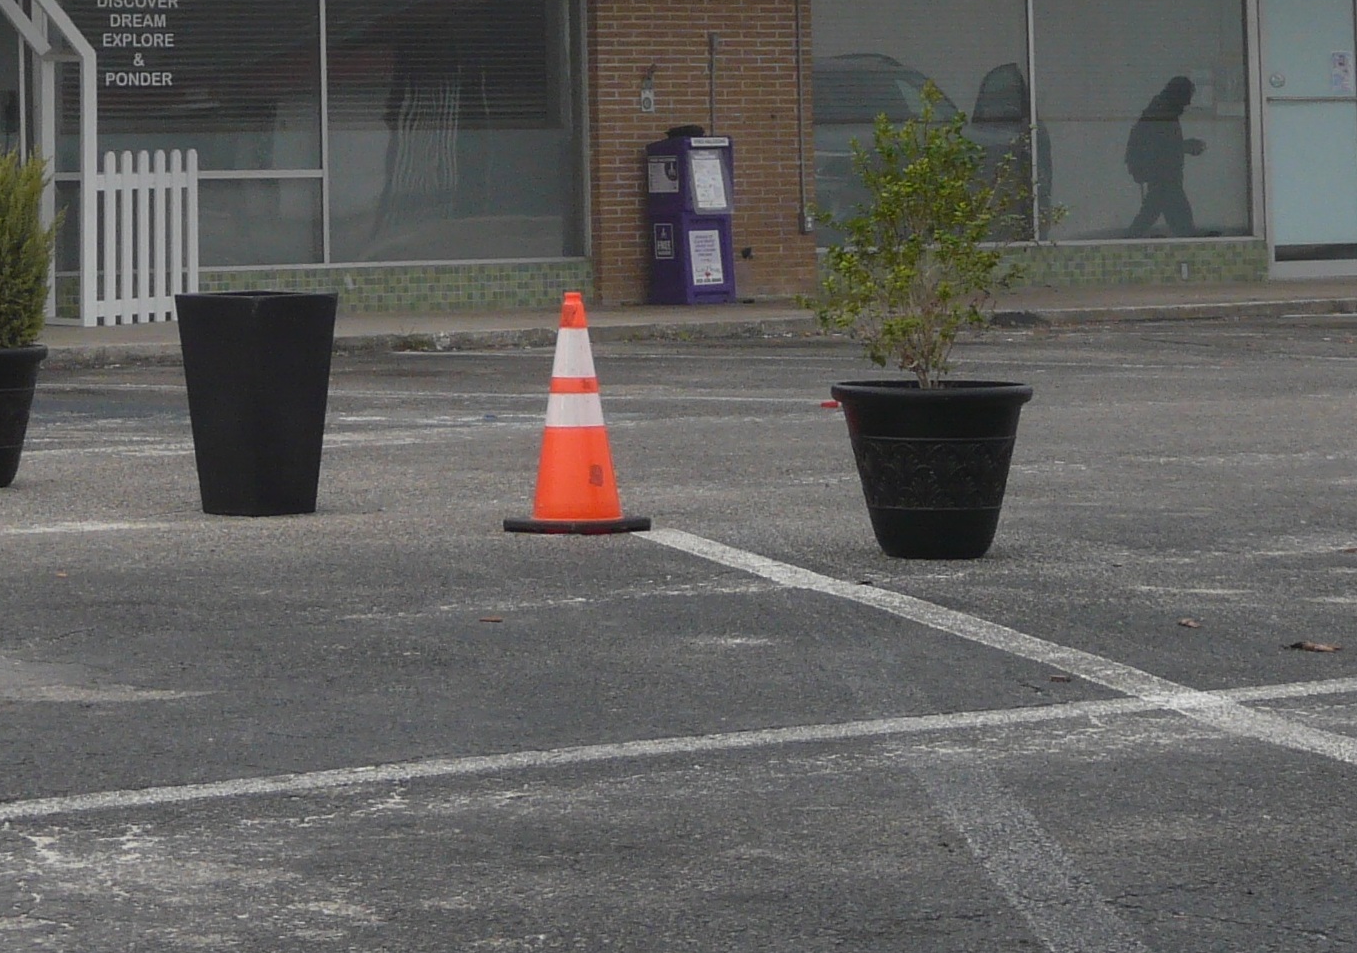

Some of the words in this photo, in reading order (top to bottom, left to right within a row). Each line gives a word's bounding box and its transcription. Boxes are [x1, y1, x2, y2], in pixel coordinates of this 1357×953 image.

[109, 13, 167, 28] DREAM
[102, 33, 175, 48] EXPLORE
[133, 52, 145, 67] &
[105, 72, 173, 87] PONDER
